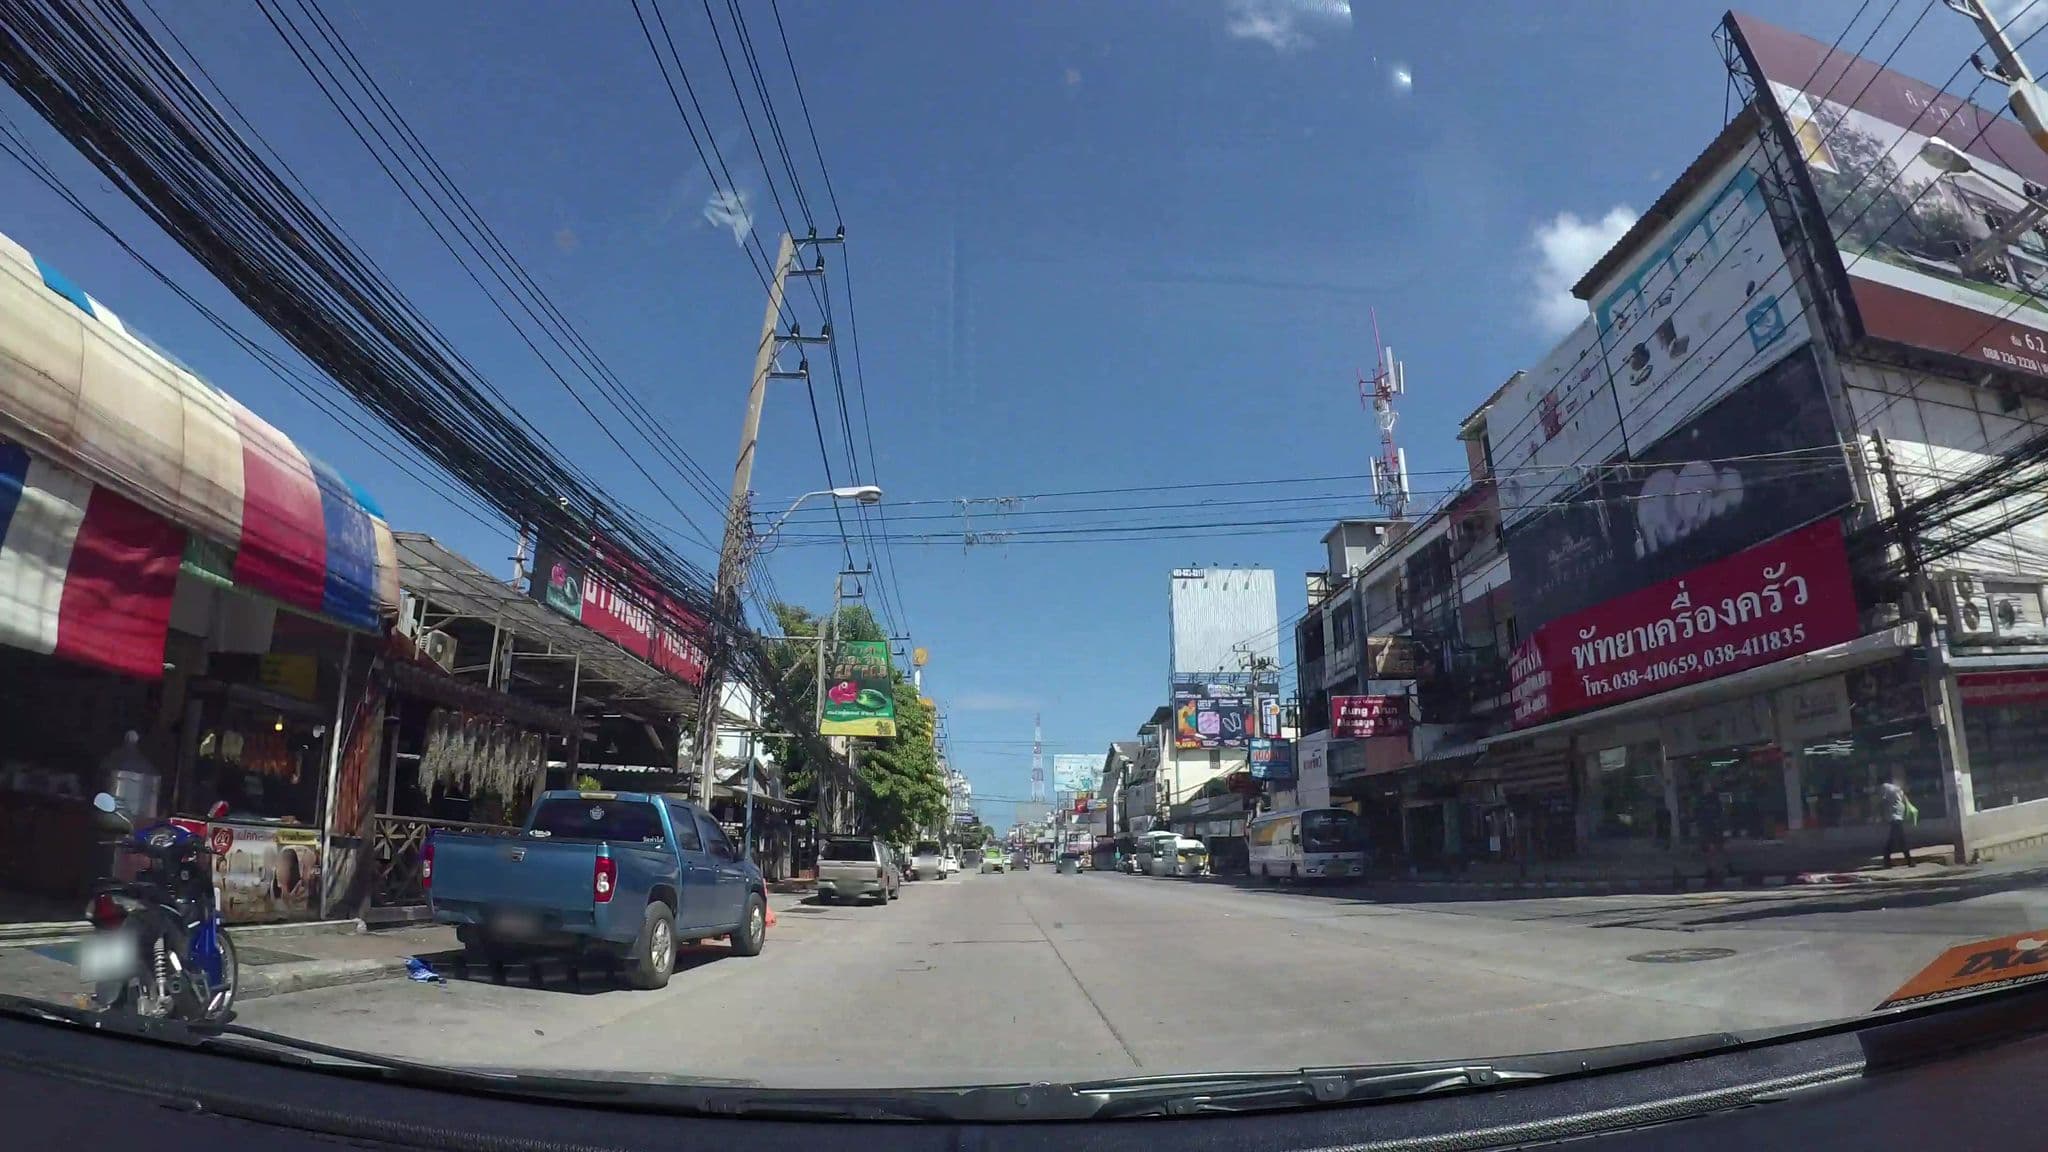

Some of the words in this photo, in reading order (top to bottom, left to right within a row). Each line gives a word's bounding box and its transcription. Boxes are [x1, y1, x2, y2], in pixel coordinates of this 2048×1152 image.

[1571, 562, 1809, 670] พัทยาเครื่องครัว
[1340, 706, 1368, 717] Rung
[1336, 718, 1375, 728] Massage
